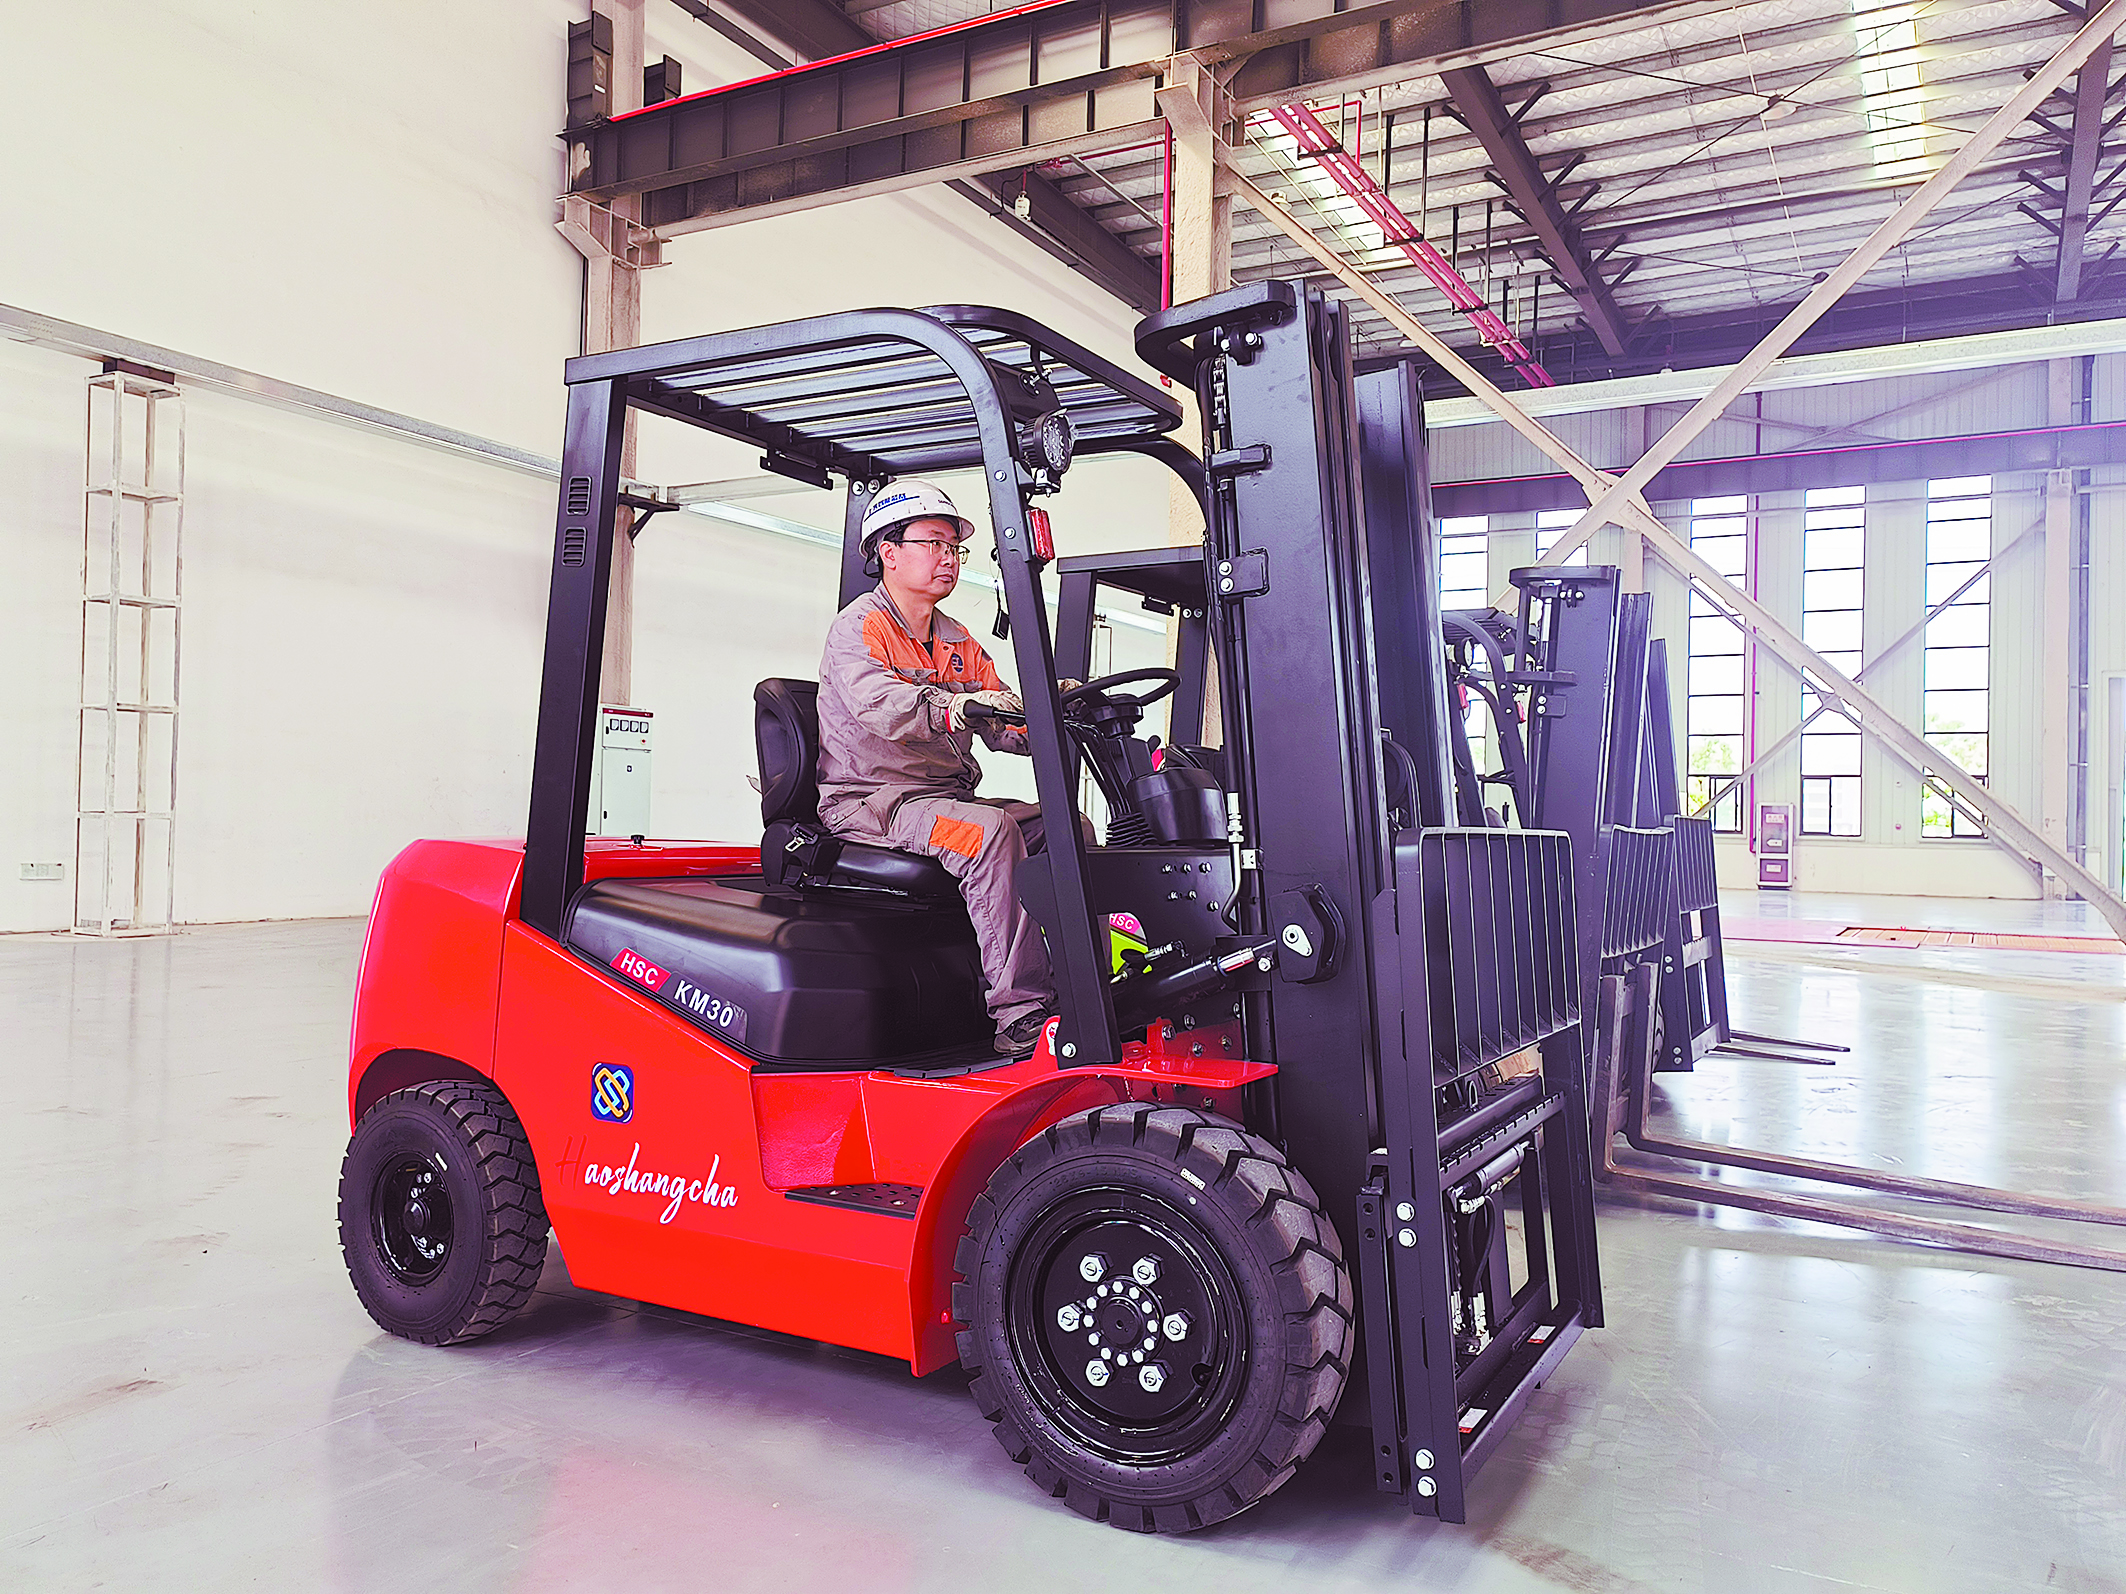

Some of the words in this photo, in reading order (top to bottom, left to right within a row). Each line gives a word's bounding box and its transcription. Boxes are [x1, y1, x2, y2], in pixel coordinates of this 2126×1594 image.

[1109, 913, 1134, 930] HSC
[620, 952, 659, 986] HSC
[673, 979, 734, 1028] KM30
